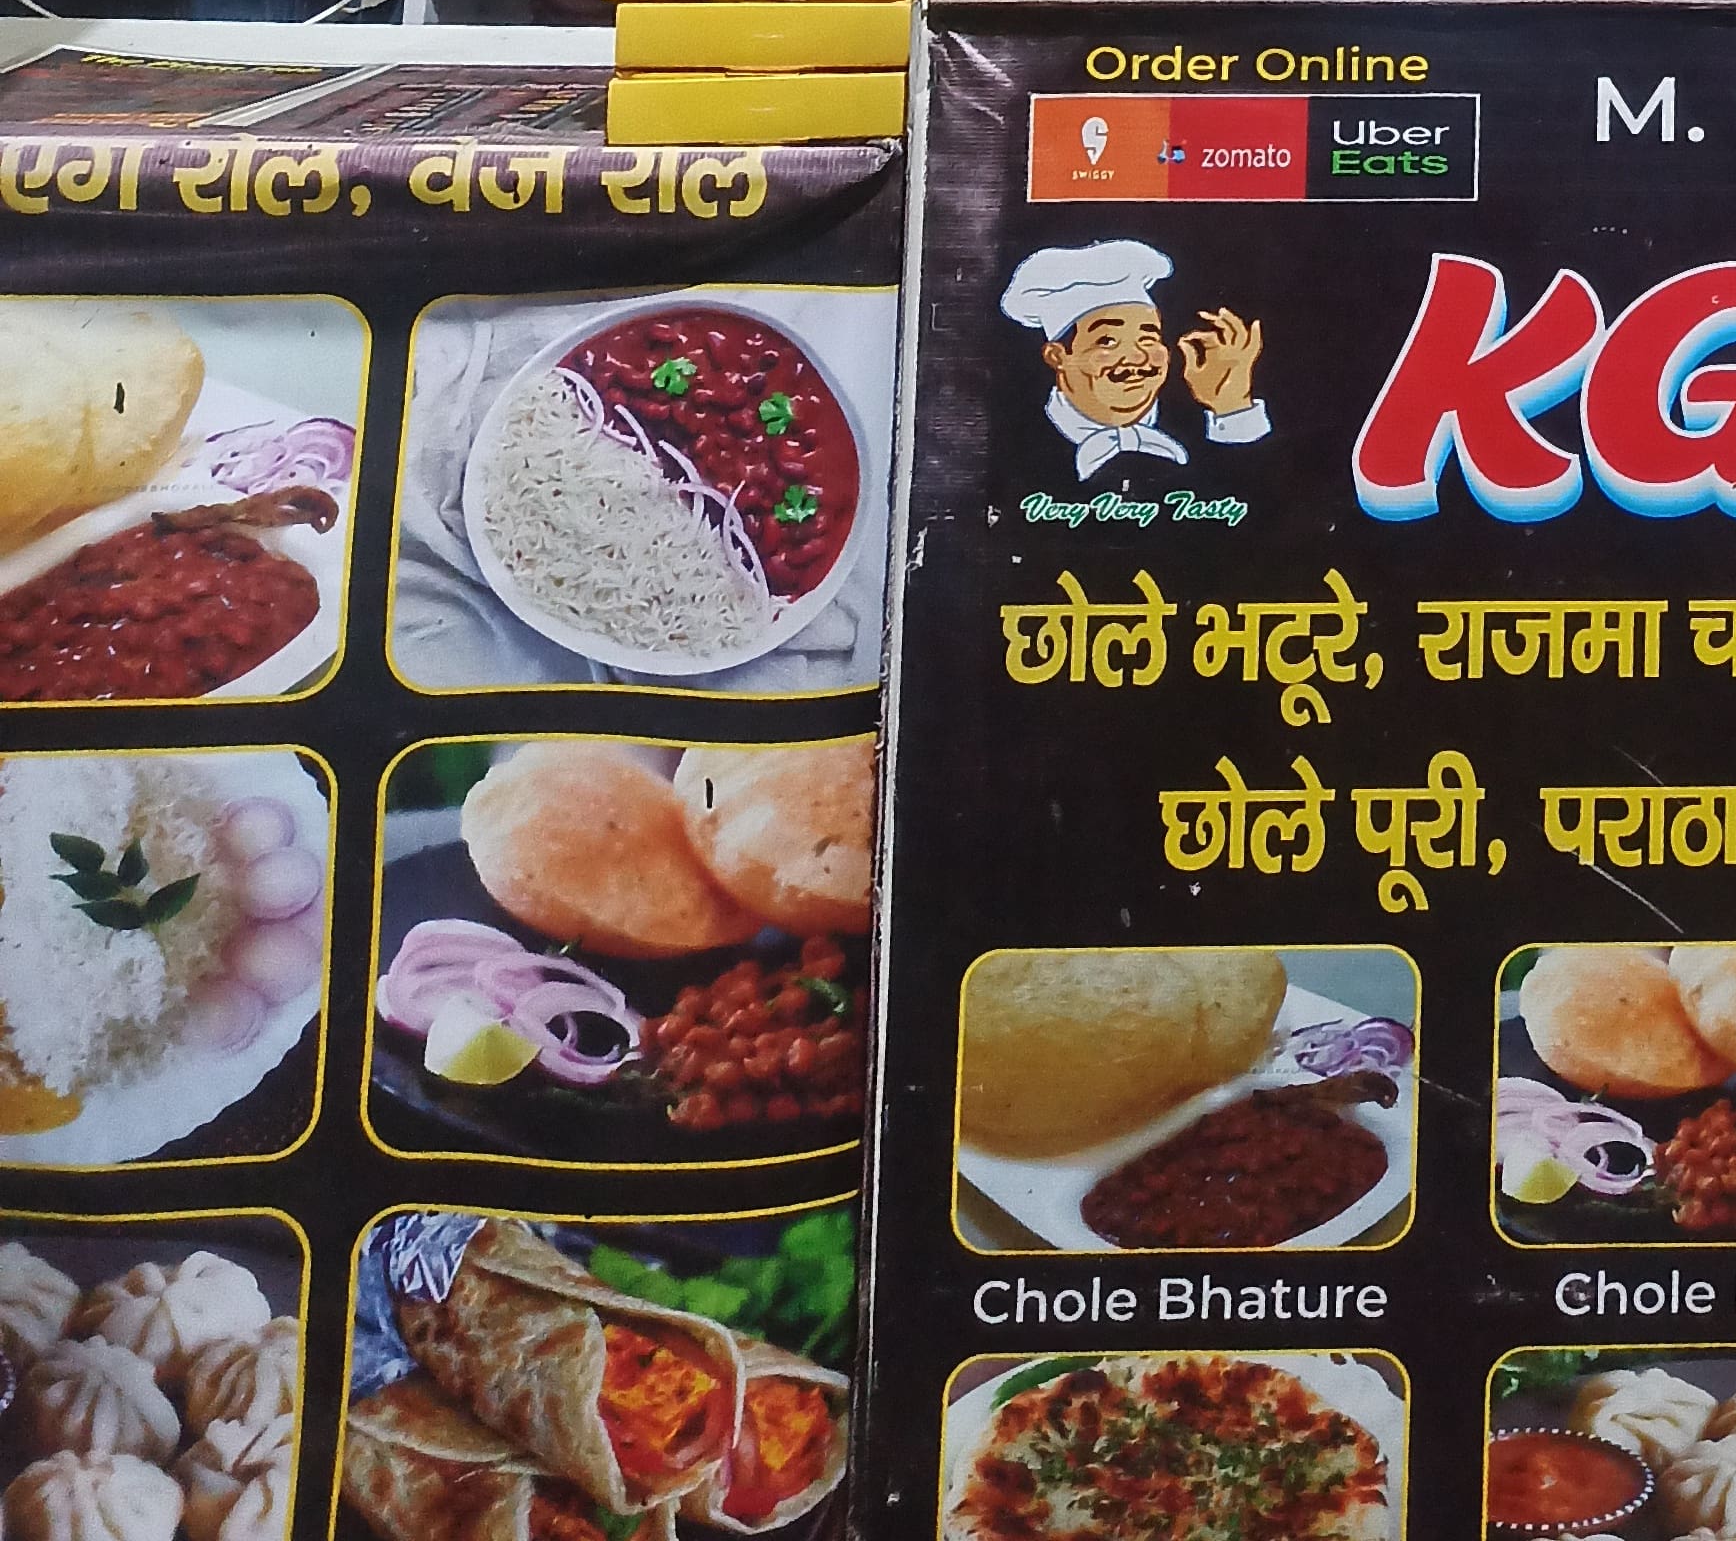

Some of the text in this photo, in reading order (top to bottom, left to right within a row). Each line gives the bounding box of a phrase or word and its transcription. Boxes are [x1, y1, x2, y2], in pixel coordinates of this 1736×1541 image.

[1086, 46, 1429, 82] Order Online
[1595, 77, 1704, 143] M.
[1333, 121, 1449, 145] Uber
[1202, 145, 1291, 168] zomato
[1332, 151, 1448, 175] Eats
[1021, 489, 1248, 525] Very Very Tasty
[1002, 570, 1177, 687] छोले
[1195, 568, 1384, 726] भटूरे,
[1417, 599, 1668, 681] राजमा
[1160, 755, 1334, 874] छोले
[1352, 750, 1508, 913] पूरी,
[973, 1276, 1387, 1324] Chole Bhature
[1555, 1271, 1716, 1317] Chole
